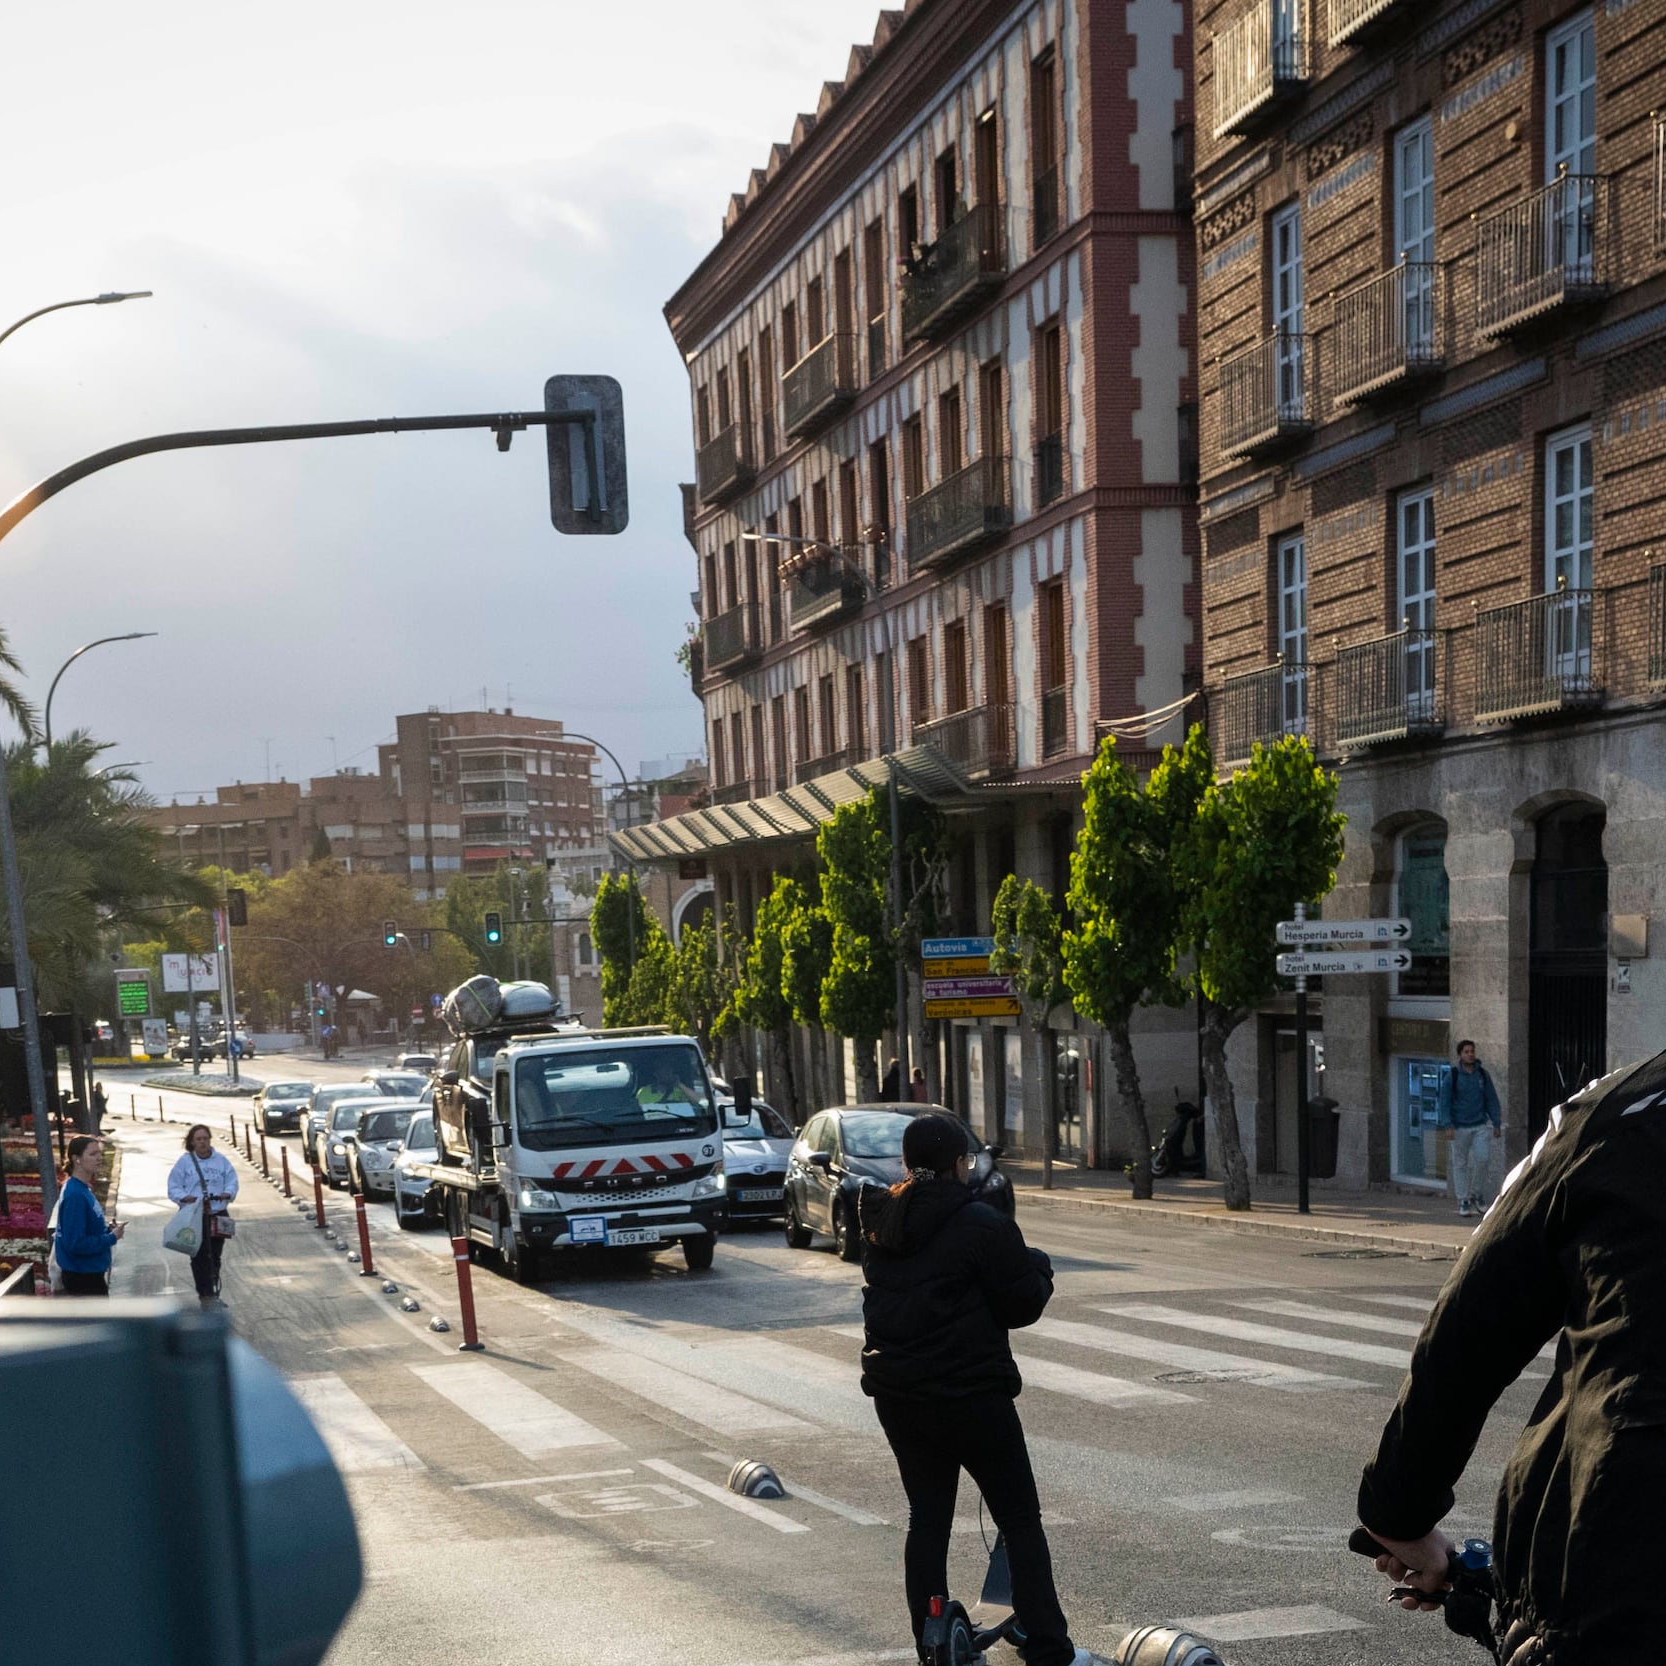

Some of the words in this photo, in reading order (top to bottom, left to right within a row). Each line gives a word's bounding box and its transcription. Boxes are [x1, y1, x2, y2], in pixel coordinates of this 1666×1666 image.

[1284, 922, 1304, 931] hotel
[1284, 930, 1328, 942] Hesperia
[1330, 929, 1364, 939] Murcia
[926, 968, 943, 976] San
[1285, 962, 1310, 973] Zenit
[1312, 962, 1346, 971] Murcia
[926, 982, 955, 990] escuela
[956, 980, 1002, 988] universitaria
[939, 988, 968, 996] turismo
[703, 1146, 714, 1156] 97
[583, 1175, 668, 1188] FUSO
[611, 1233, 637, 1245] 1459
[638, 1231, 659, 1242] MCC
